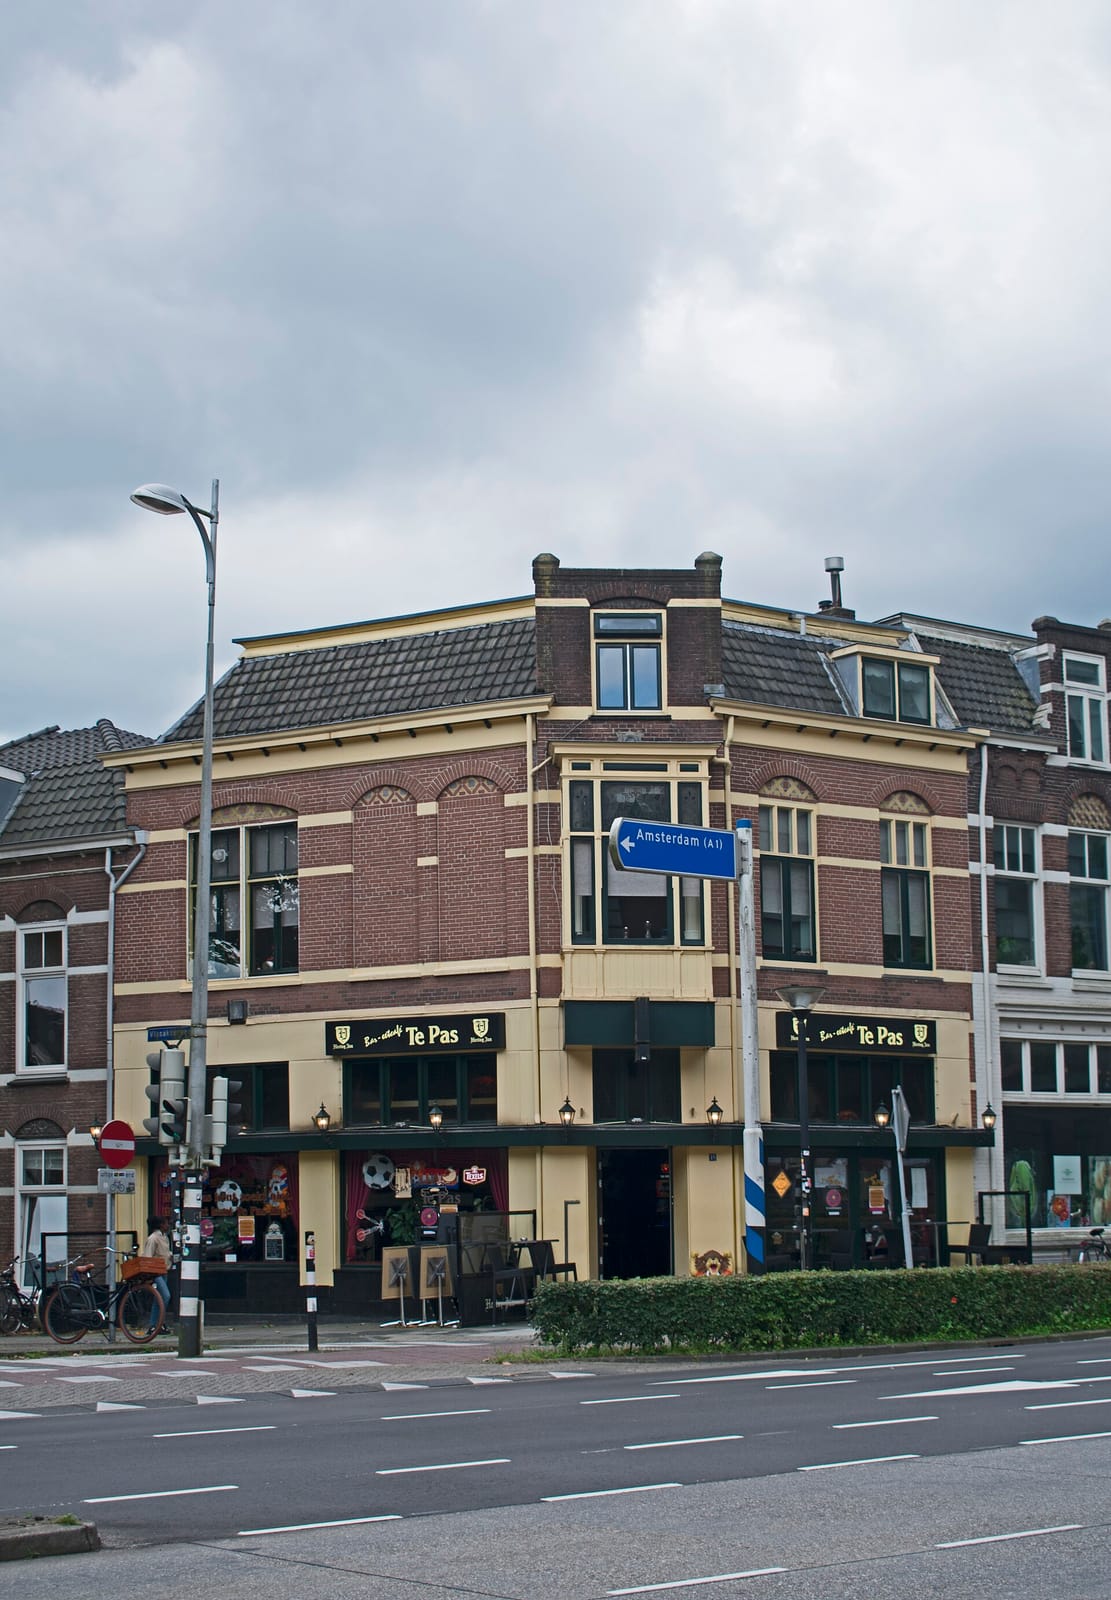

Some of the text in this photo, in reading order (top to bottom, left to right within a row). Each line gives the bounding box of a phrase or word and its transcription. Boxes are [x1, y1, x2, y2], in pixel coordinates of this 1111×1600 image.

[636, 828, 700, 847] Amsterdam
[405, 1027, 425, 1046] Te
[428, 1025, 459, 1044] Pas
[857, 1025, 874, 1045] Te
[877, 1026, 904, 1046] Pas
